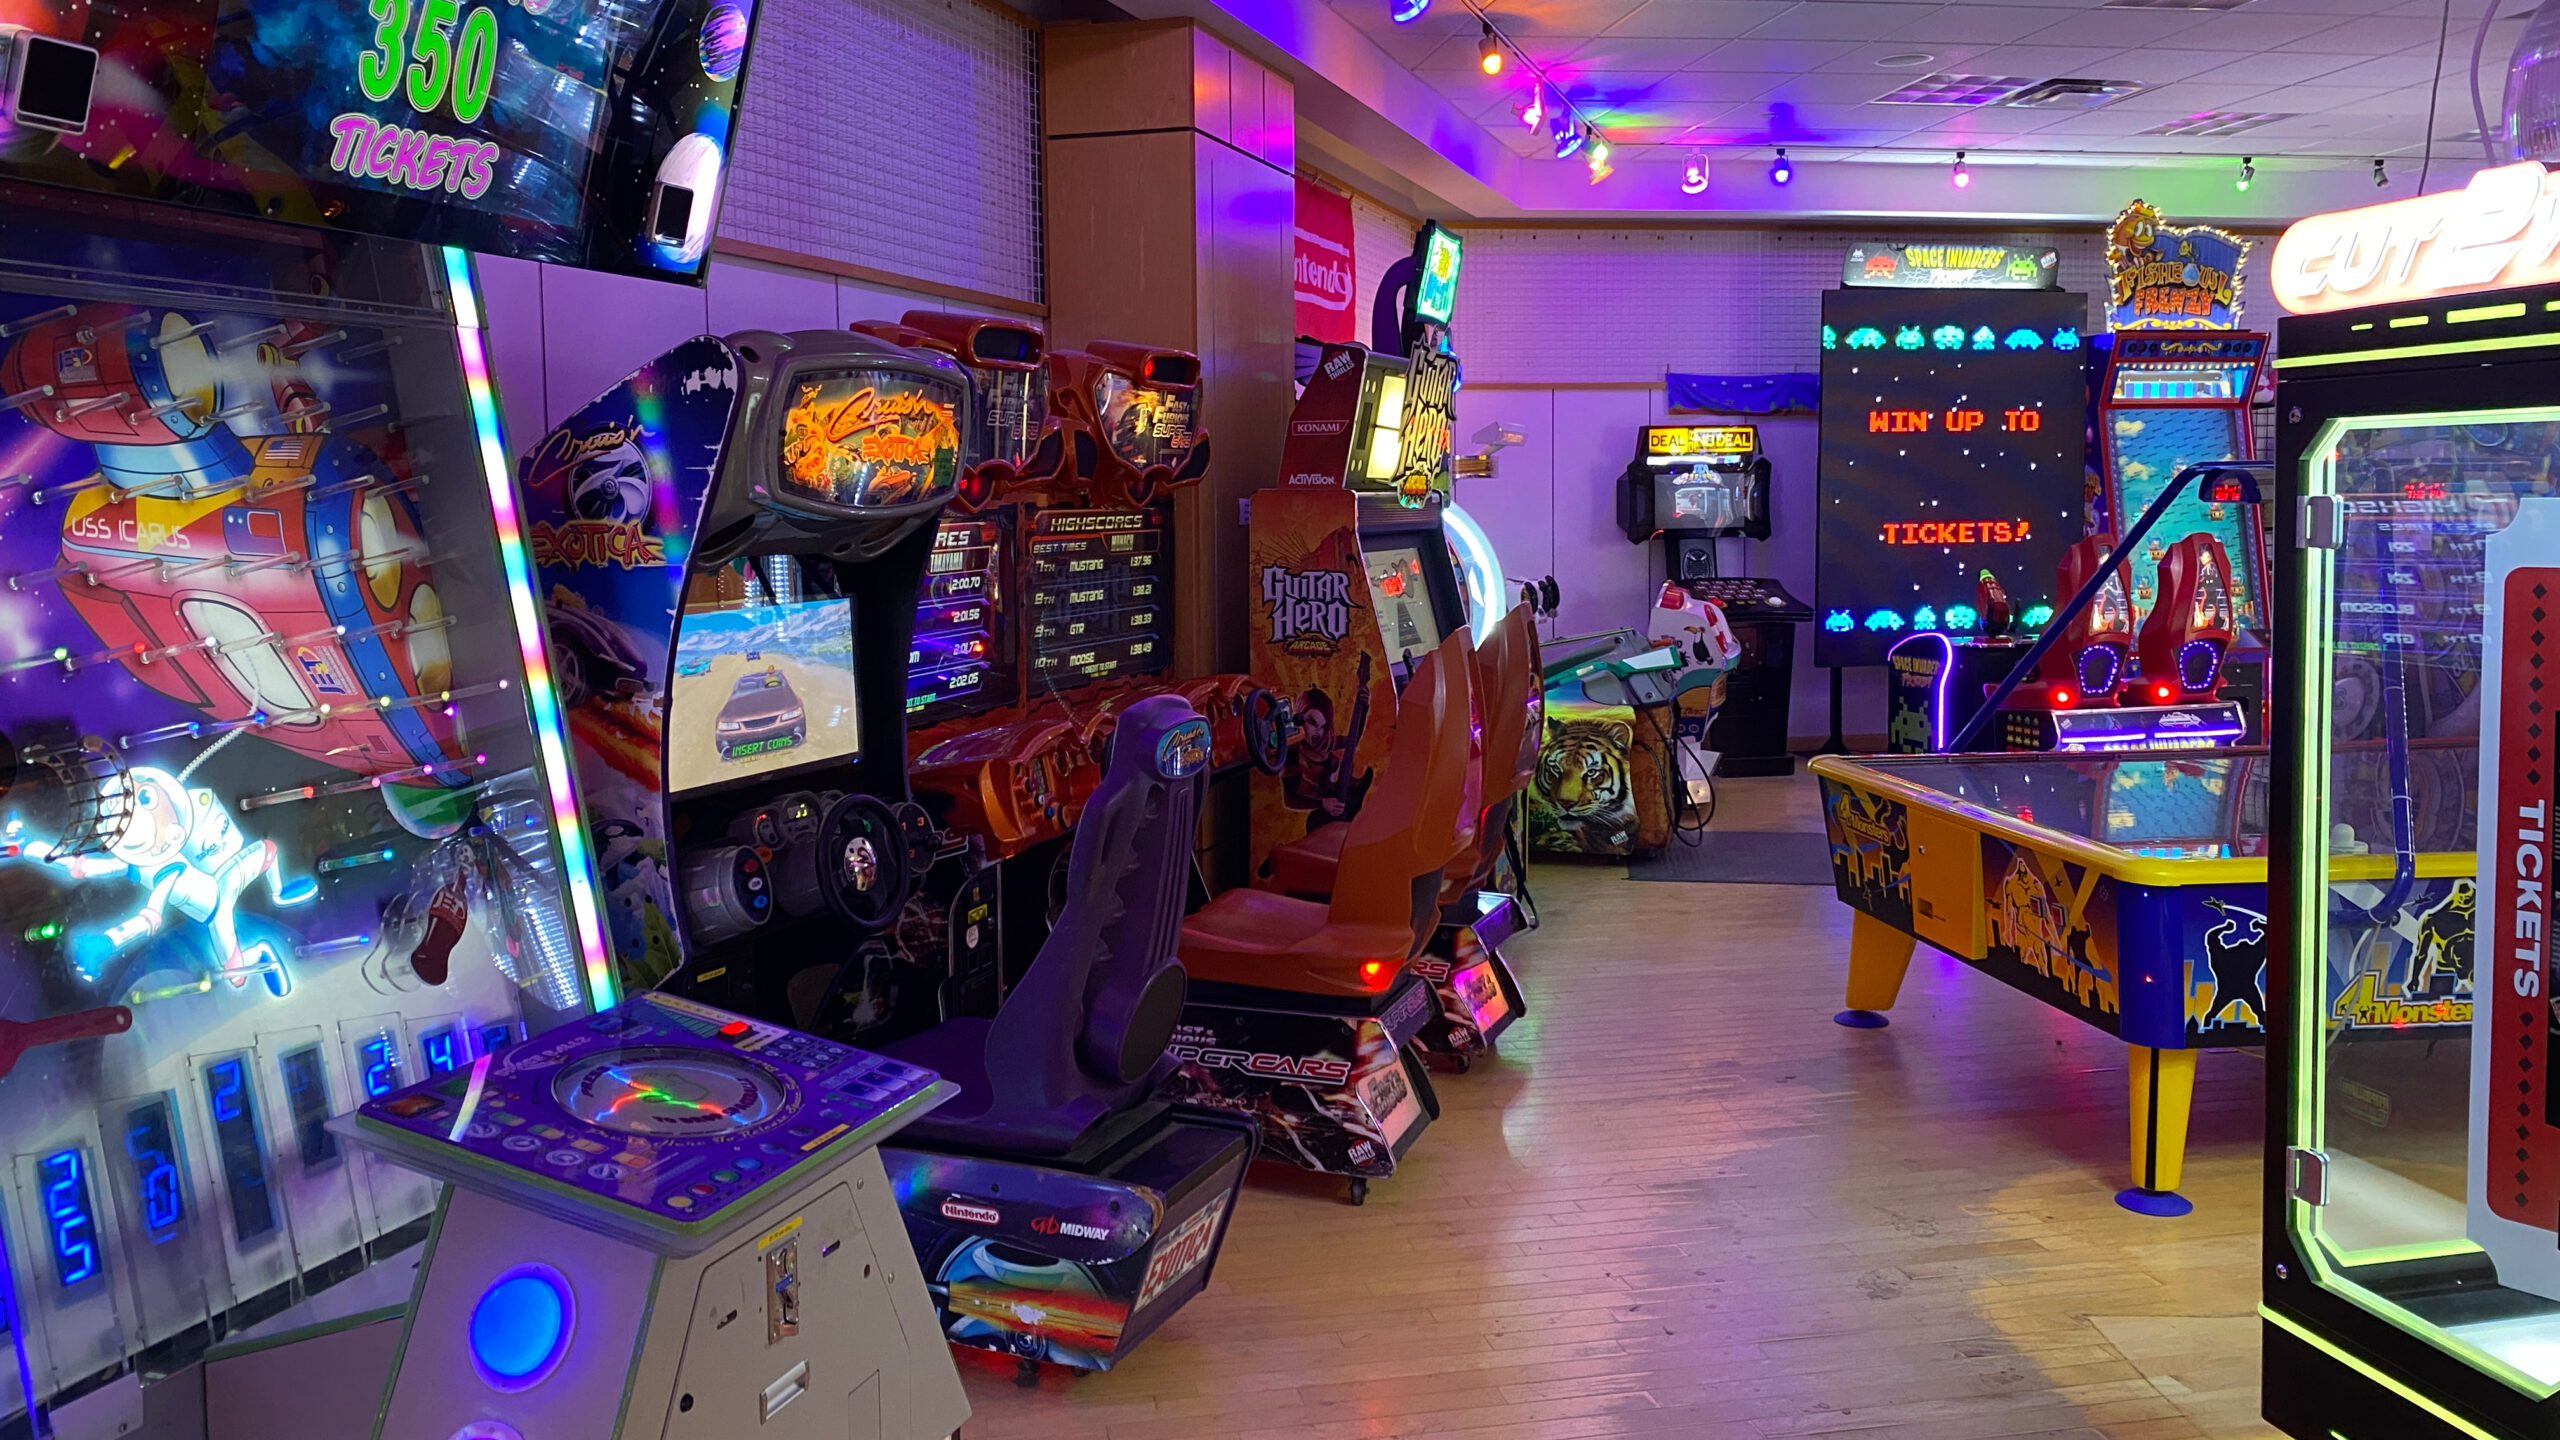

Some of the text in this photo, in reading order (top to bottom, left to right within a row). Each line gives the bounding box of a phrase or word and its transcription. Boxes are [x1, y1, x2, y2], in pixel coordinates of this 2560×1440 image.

[359, 0, 498, 123] 350
[330, 112, 500, 199] TICKETS
[1906, 248, 2005, 269] SPACE INVADERS
[2296, 215, 2444, 299] CUT
[1295, 255, 1351, 297] ntendo
[2133, 287, 2215, 316] FRENZY
[1324, 352, 1352, 374] RAW
[1329, 361, 1355, 381] THRILLS
[1405, 345, 1457, 421] GUITAR
[1297, 424, 1340, 433] KONAMI
[1869, 411, 2040, 432] WIN UP TO
[860, 435, 930, 465] EXOTICA
[1651, 435, 1685, 447] DEAL
[1717, 434, 1750, 447] DEAL
[1288, 473, 1335, 486] ACTIVISION
[72, 517, 191, 549] USS ICARUS
[1050, 515, 1142, 532] HIGHSCORES
[1883, 521, 2029, 545] TICKETS!
[530, 522, 667, 572] EXOTICA
[1033, 543, 1058, 553] BEST
[1262, 562, 1364, 609] GUITAR
[1034, 592, 1055, 604] 8TH
[1034, 625, 1055, 637] 9TH
[1267, 598, 1350, 643] HERO
[1289, 641, 1331, 650] ARCADE
[732, 742, 765, 757] INSERT
[767, 736, 793, 750] COINS
[2513, 799, 2545, 998] TICKETS
[212, 1060, 242, 1122] 2
[944, 1204, 997, 1222] Nintendo
[1060, 1222, 1110, 1241] MIDWAY
[1142, 1217, 1215, 1298] EXOTICA
